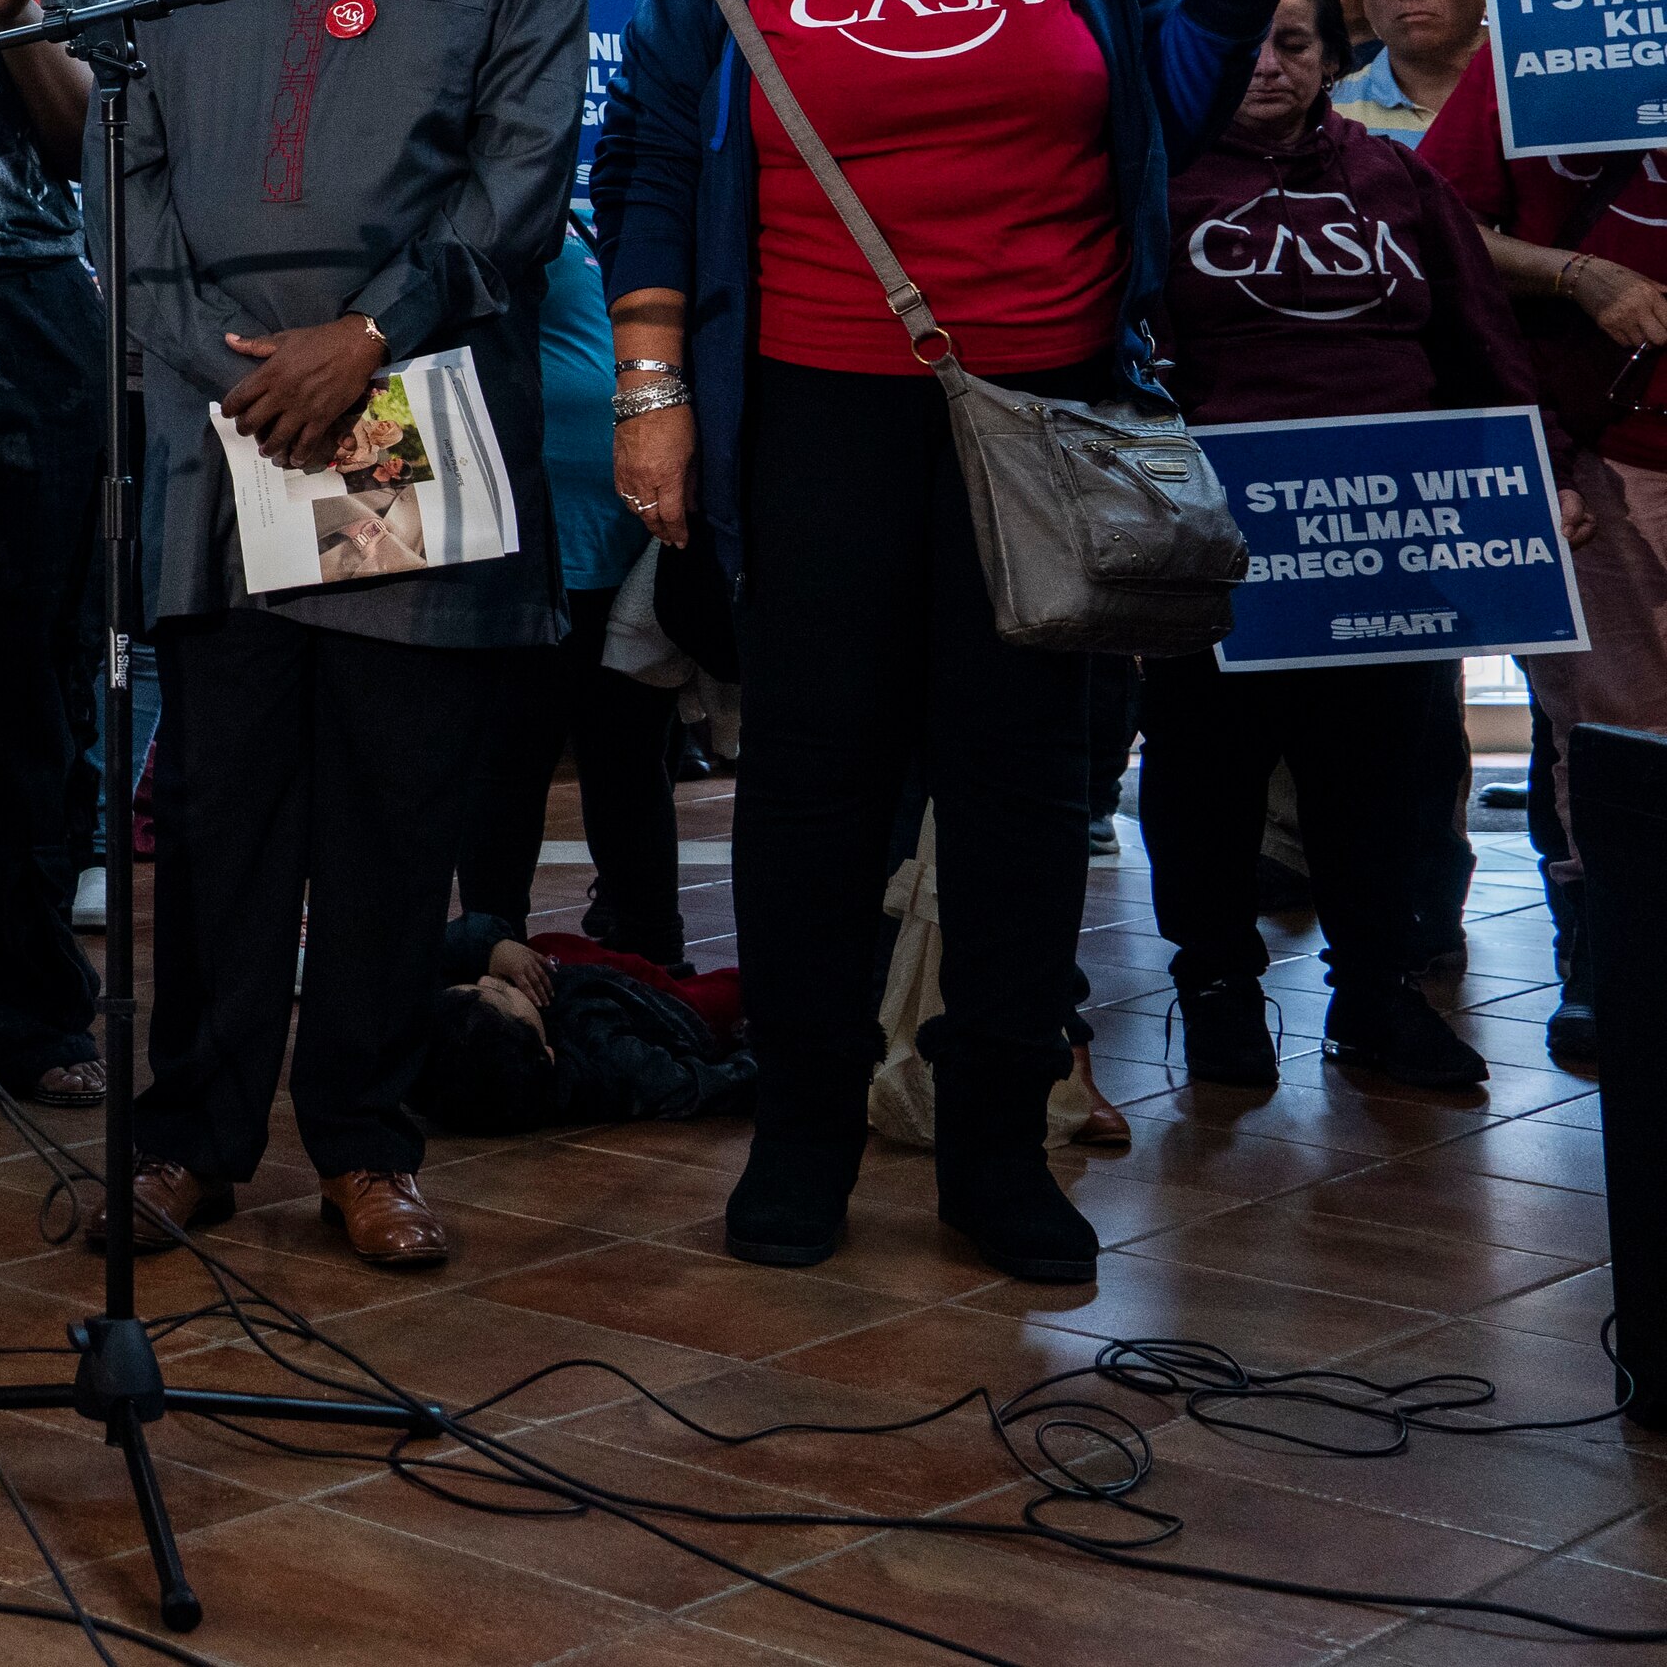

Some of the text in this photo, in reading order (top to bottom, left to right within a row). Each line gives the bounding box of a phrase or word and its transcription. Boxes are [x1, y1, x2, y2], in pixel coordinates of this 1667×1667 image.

[333, 5, 365, 25] CASA
[1514, 41, 1667, 78] ABREG
[1189, 219, 1425, 281] CASA
[1245, 474, 1398, 513] STAND
[1412, 465, 1529, 502] WITH
[1295, 506, 1464, 545] KILMAR
[1246, 537, 1554, 583] BREGO GARCIA
[1330, 612, 1458, 640] SMART
